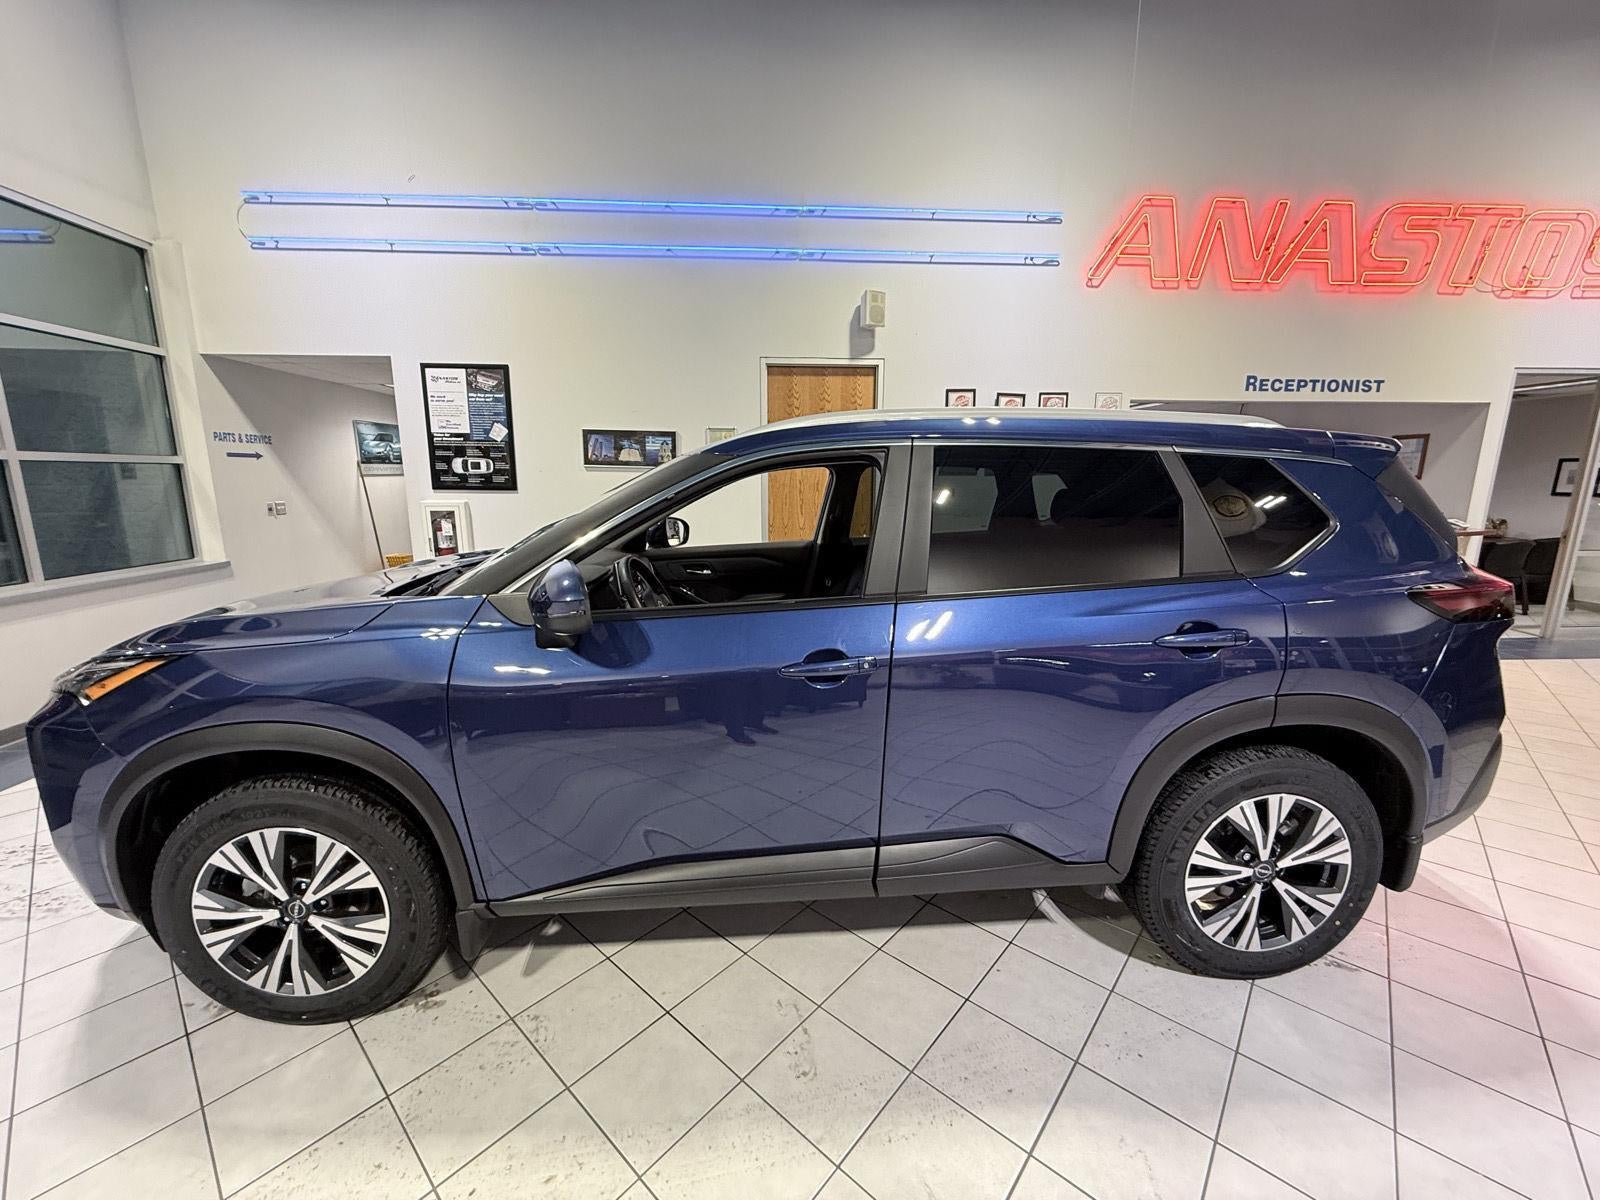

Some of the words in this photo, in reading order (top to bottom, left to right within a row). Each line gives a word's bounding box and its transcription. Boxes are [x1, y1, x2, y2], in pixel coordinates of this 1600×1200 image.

[1245, 375, 1385, 393] RECEPTIONIST
[213, 431, 236, 443] PARTS
[238, 433, 244, 444] &
[244, 433, 273, 445] SERVICE
